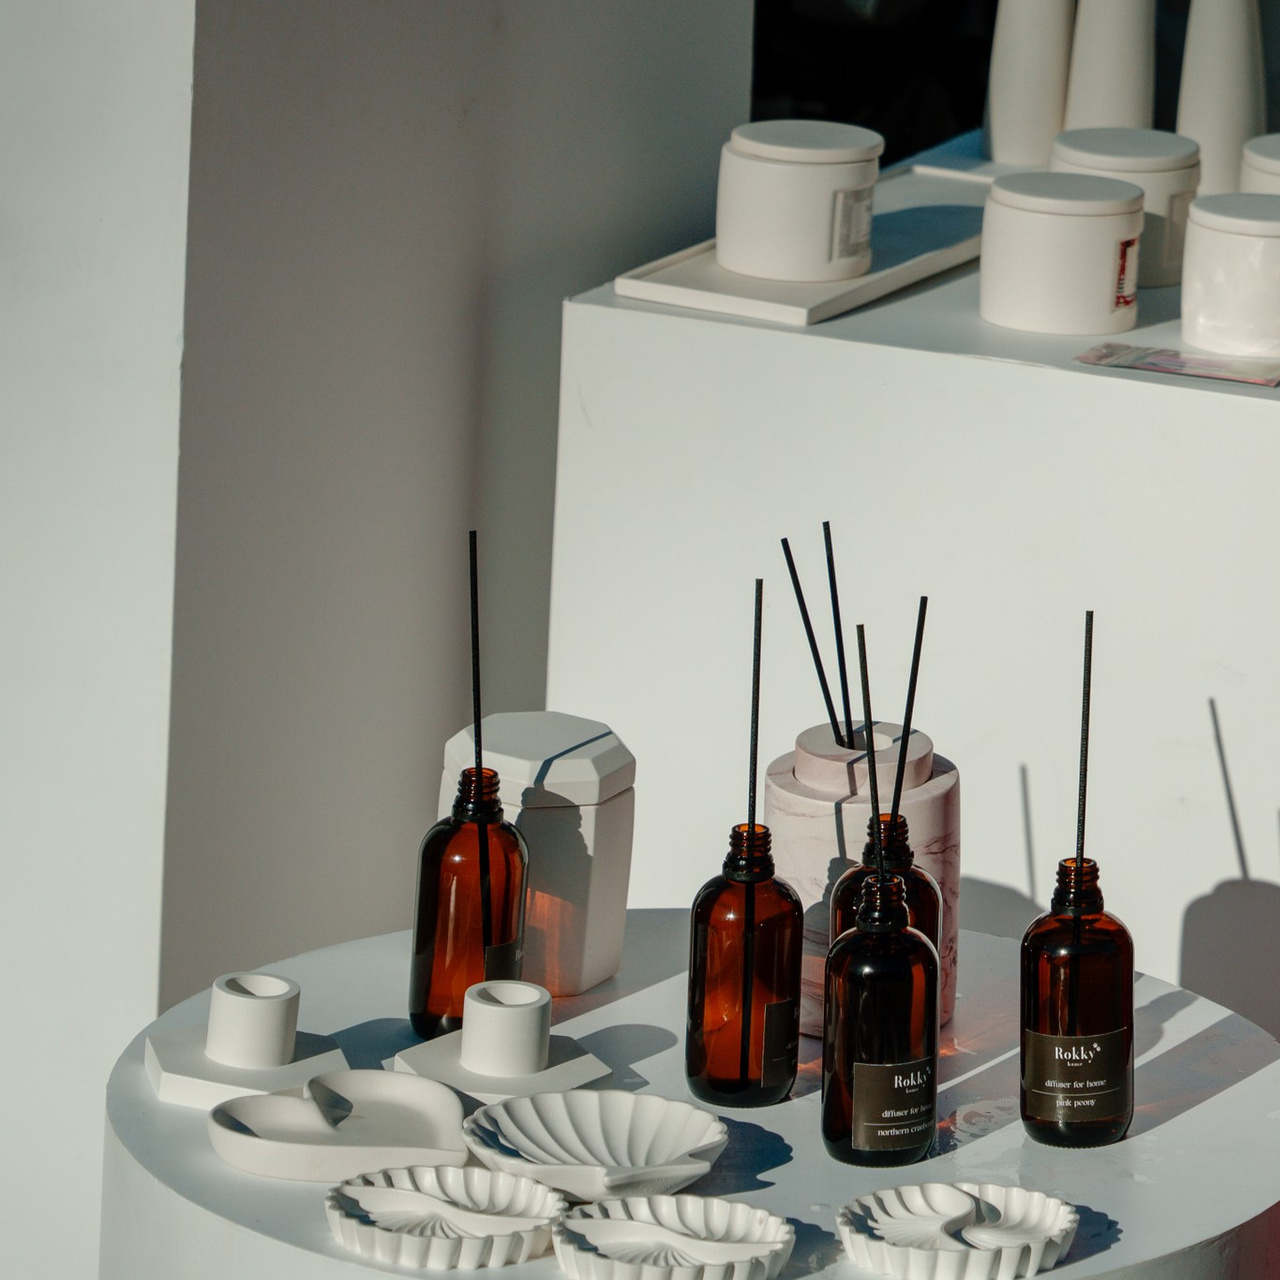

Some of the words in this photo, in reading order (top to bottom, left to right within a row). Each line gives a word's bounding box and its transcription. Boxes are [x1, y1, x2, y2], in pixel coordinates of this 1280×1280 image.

[1055, 1046, 1096, 1064] Rokky
[1045, 1080, 1071, 1089] diffuser
[1073, 1080, 1085, 1089] for
[1086, 1079, 1107, 1088] home
[1056, 1099, 1072, 1108] pink
[1074, 1099, 1096, 1108] peony
[882, 1109, 909, 1118] diffuser
[910, 1106, 919, 1115] for
[877, 1127, 909, 1136] northern
